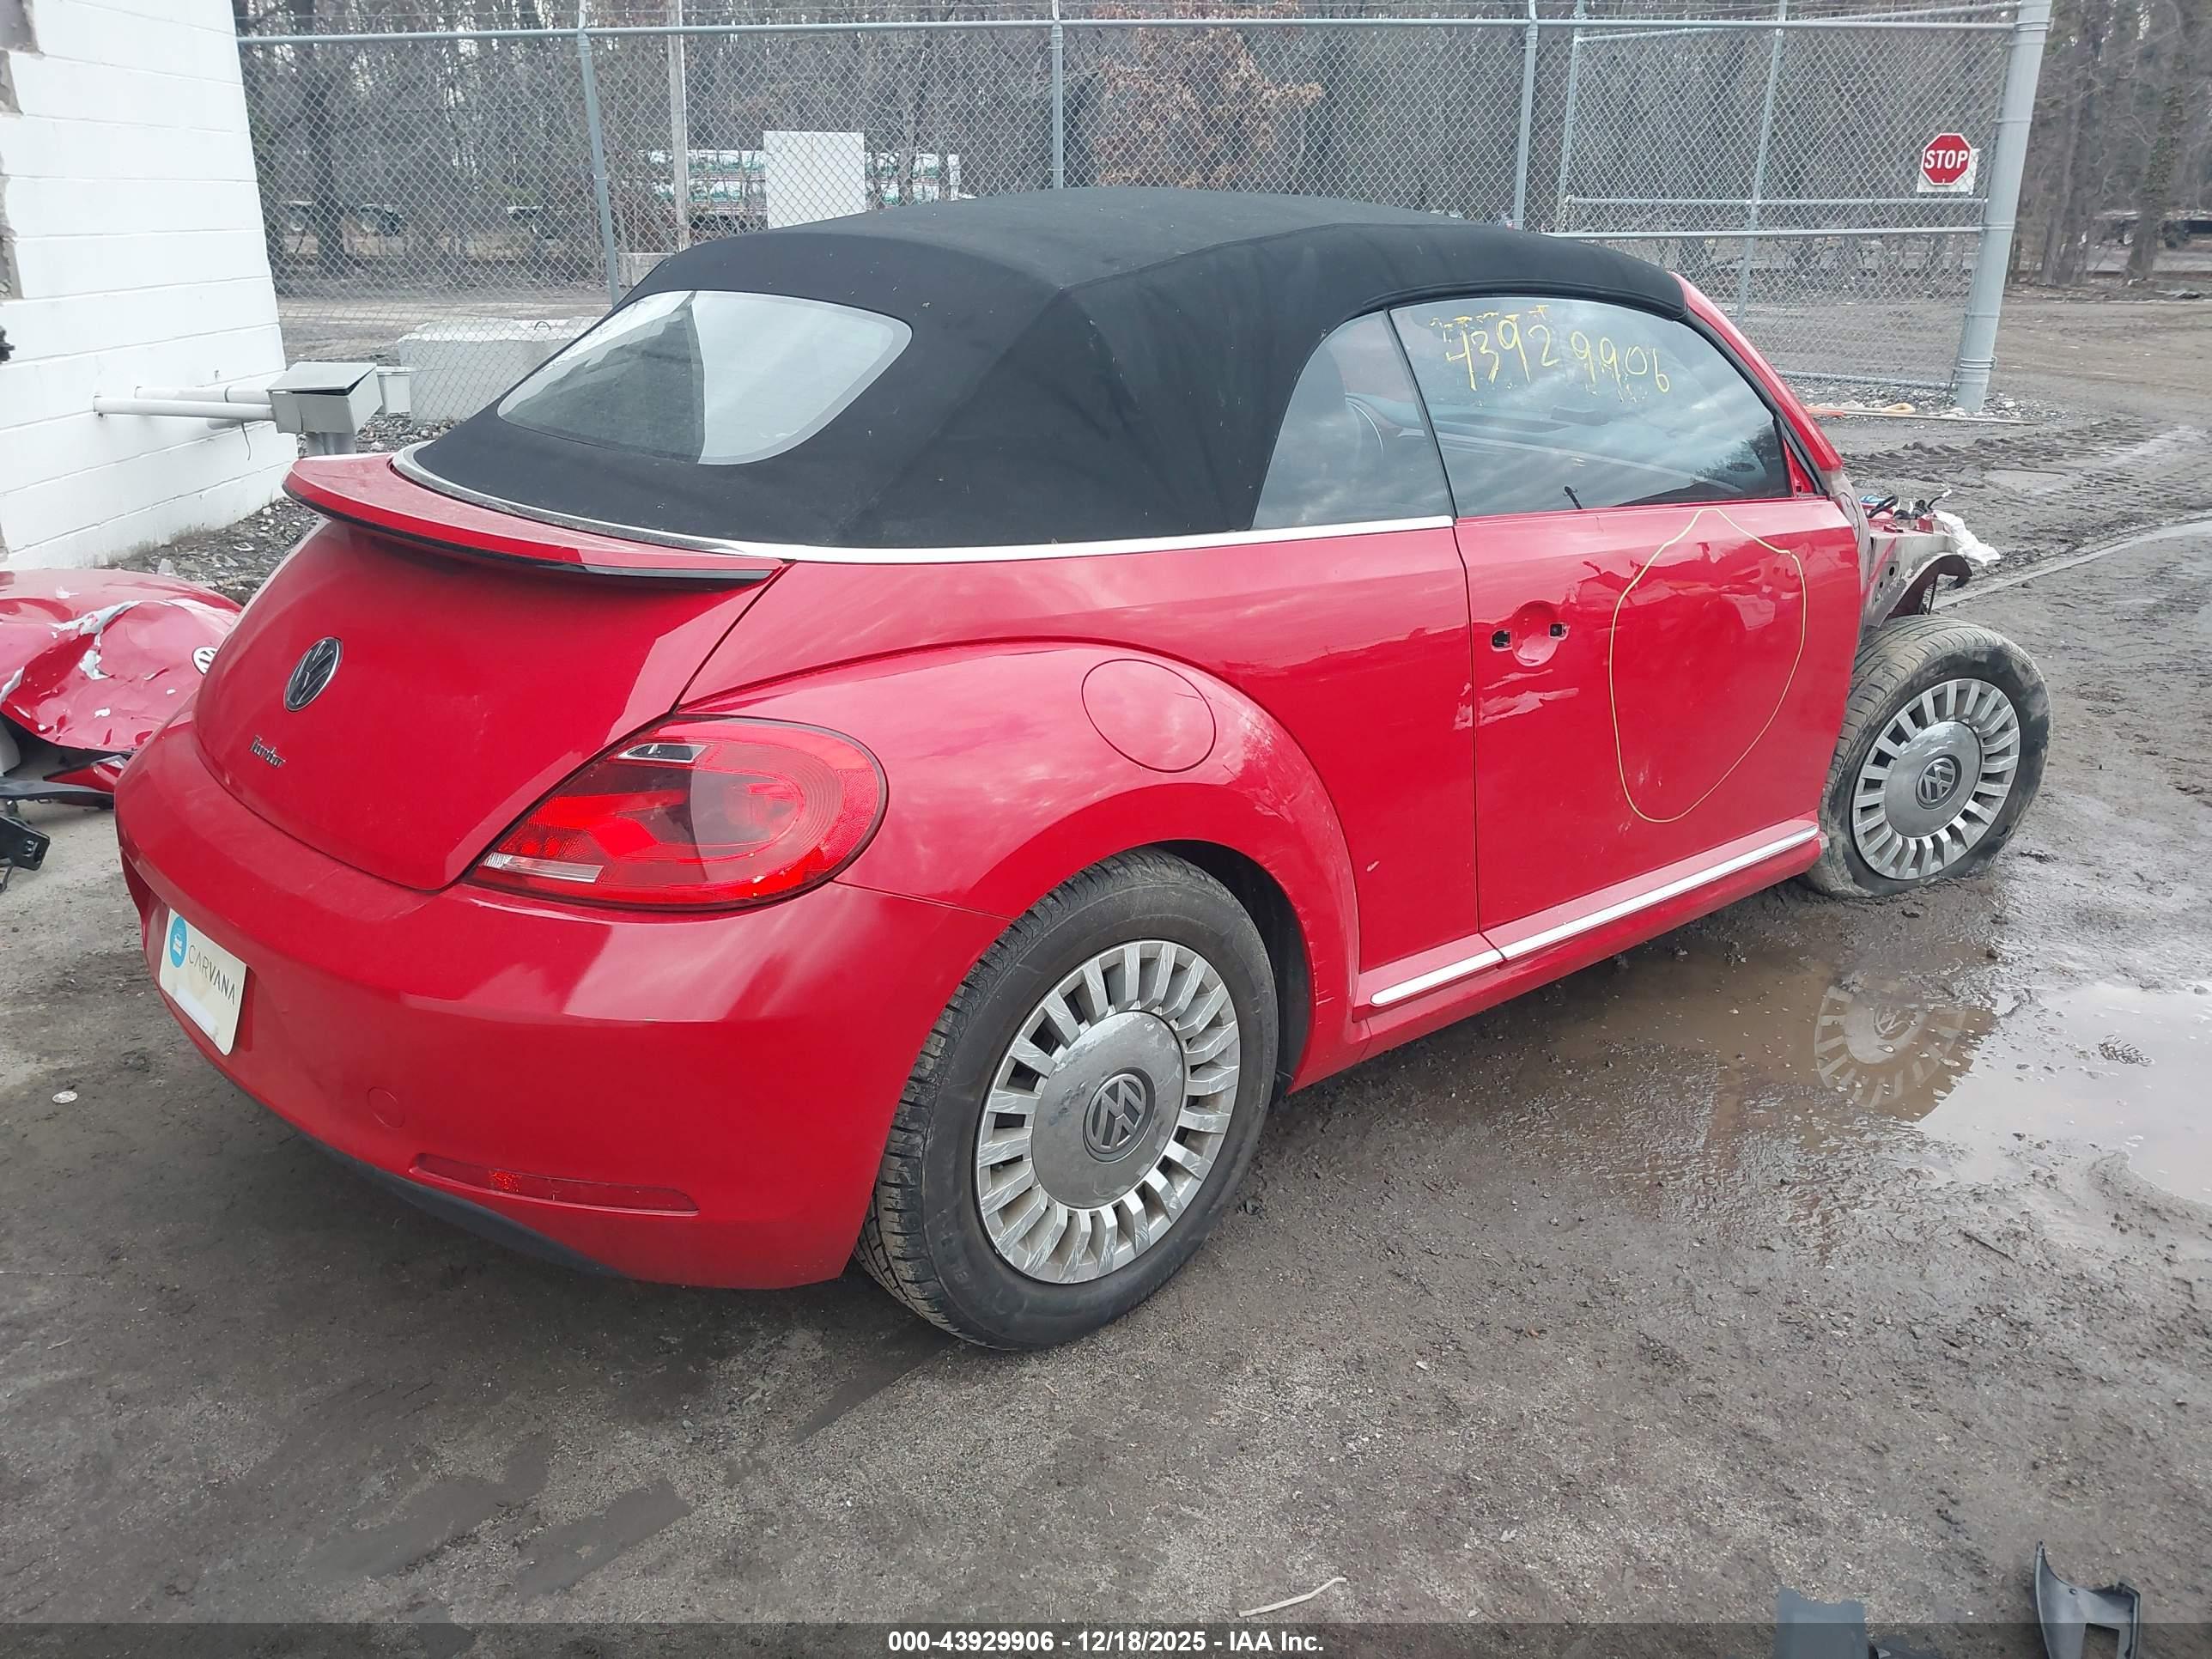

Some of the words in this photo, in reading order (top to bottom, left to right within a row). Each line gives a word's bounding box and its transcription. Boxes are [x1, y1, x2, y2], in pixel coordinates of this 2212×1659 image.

[1924, 149, 1968, 169] STOP
[1444, 314, 1670, 403] 43929906
[188, 945, 236, 1006] CARVANA
